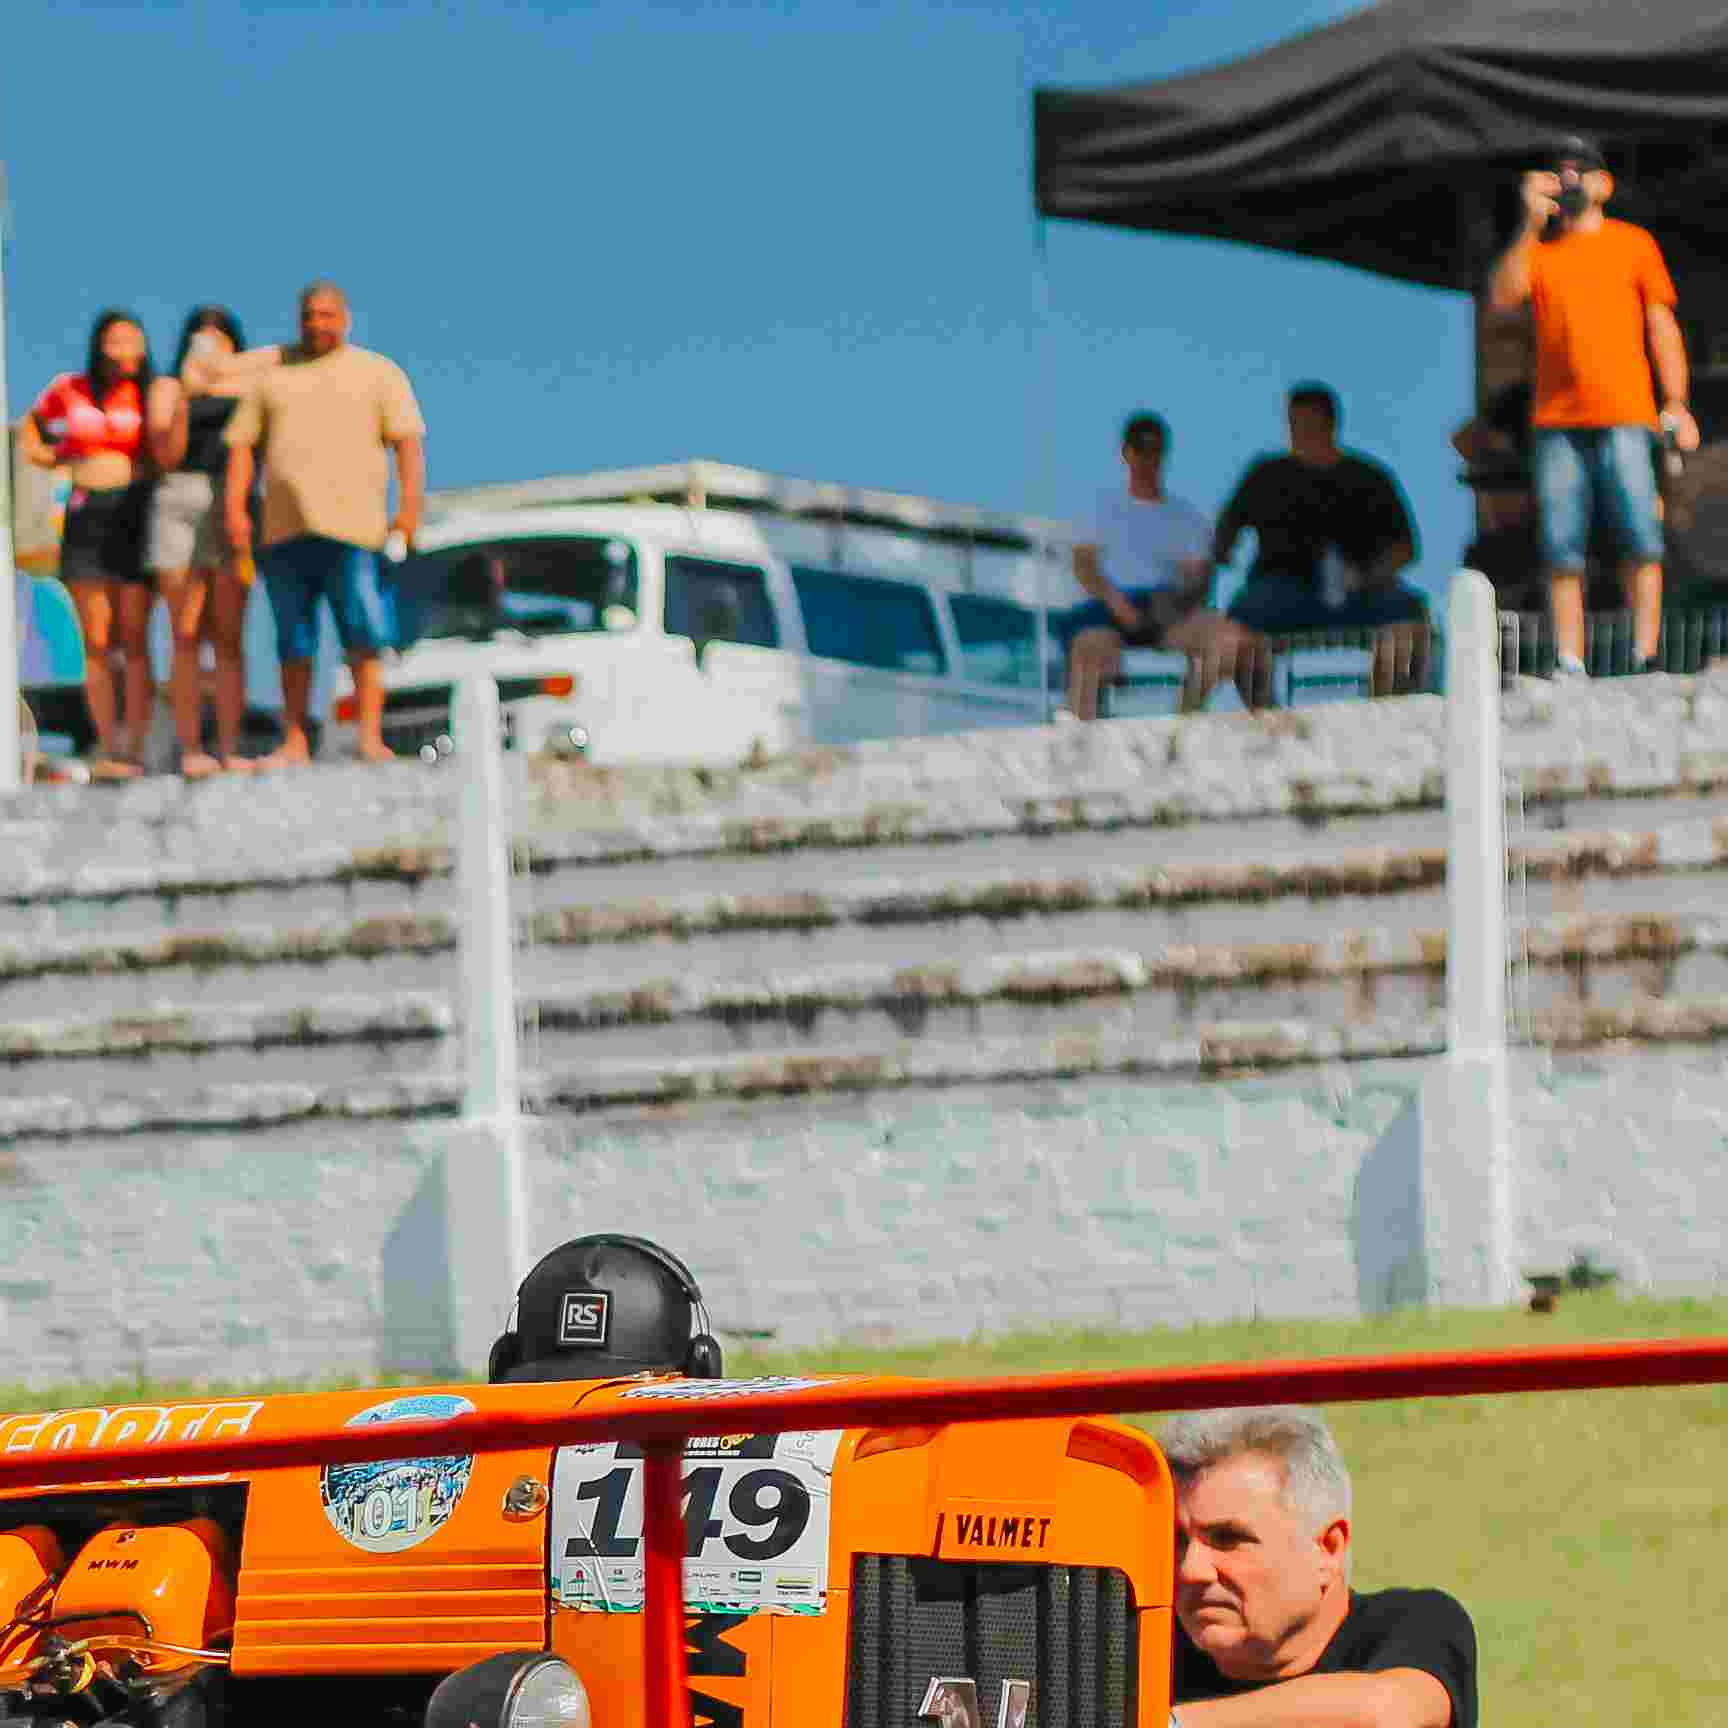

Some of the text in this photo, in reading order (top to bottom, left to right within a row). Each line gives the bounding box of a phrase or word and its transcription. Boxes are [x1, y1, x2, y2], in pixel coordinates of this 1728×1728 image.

[568, 1303, 599, 1325] RS
[564, 1466, 811, 1561] 149
[956, 1513, 1051, 1548] VALMET
[88, 1559, 139, 1572] MWM
